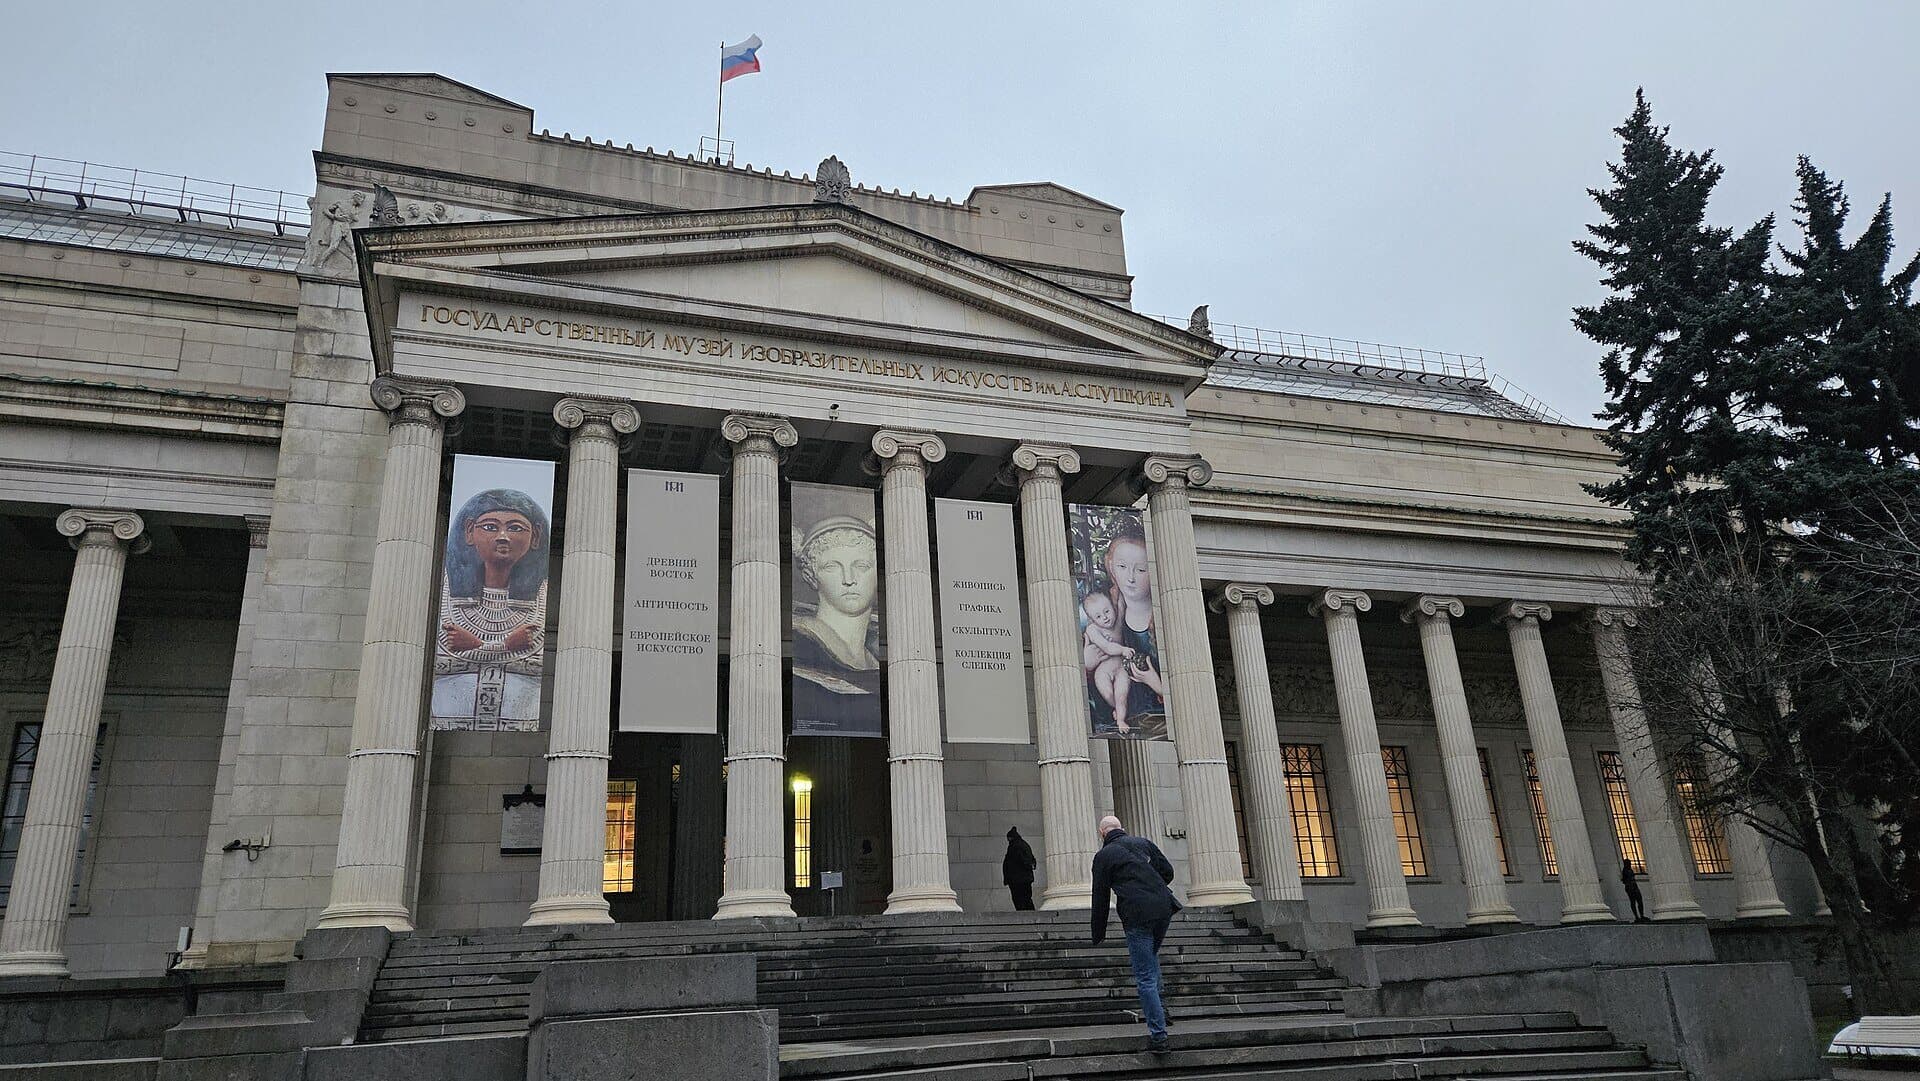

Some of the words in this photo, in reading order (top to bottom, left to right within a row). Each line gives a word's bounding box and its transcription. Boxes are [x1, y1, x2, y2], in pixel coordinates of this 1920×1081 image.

[421, 305, 656, 349] ГОСУДАРСТВЕННЫЙ
[662, 334, 733, 358] МУЗЕЙ
[741, 343, 924, 381] ИЗОБРАЗИТЕЛЬНЫХ
[931, 366, 1033, 393] ИСКУССТВ
[646, 557, 697, 568] ДРЕВНИЙ
[650, 569, 694, 580] ВОСТОК
[952, 580, 1006, 591] ЖИВОПИСЬ
[633, 599, 709, 612] АНТИЧНОСТЬ
[959, 603, 1002, 613] ГРАФИКА
[629, 630, 711, 643] ЕВРОПЕЙСКОЕ
[951, 626, 1012, 637] СКУЛЬПТУРА
[637, 643, 704, 655] ИСКУССТВО
[955, 649, 1011, 660] КОЛЛЕКЦИЯ
[961, 661, 1007, 671] СЛЕПКОВ
